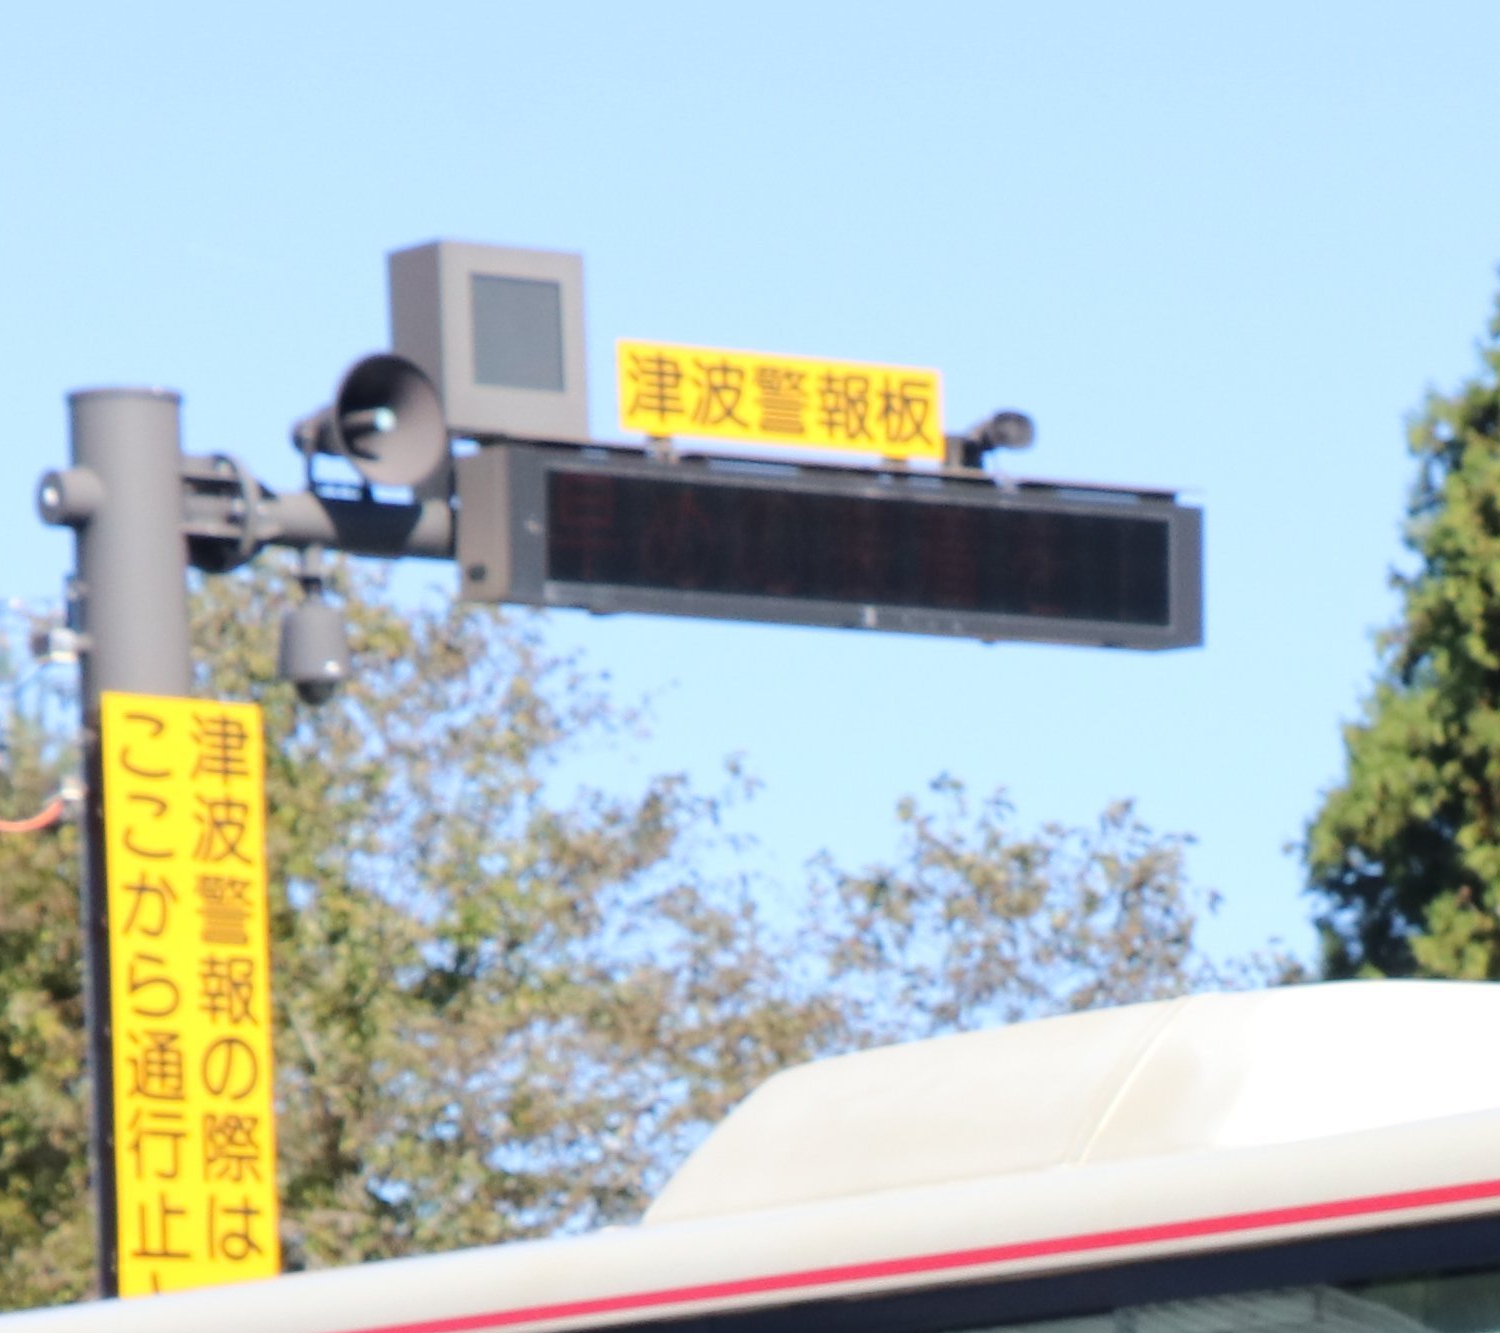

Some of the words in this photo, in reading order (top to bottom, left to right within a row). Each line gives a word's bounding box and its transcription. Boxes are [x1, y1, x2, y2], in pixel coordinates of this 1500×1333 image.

[626, 350, 934, 447] 津波警報板
[119, 711, 192, 1293] ここから通行止
[189, 712, 263, 1262] 津波警報の際は
